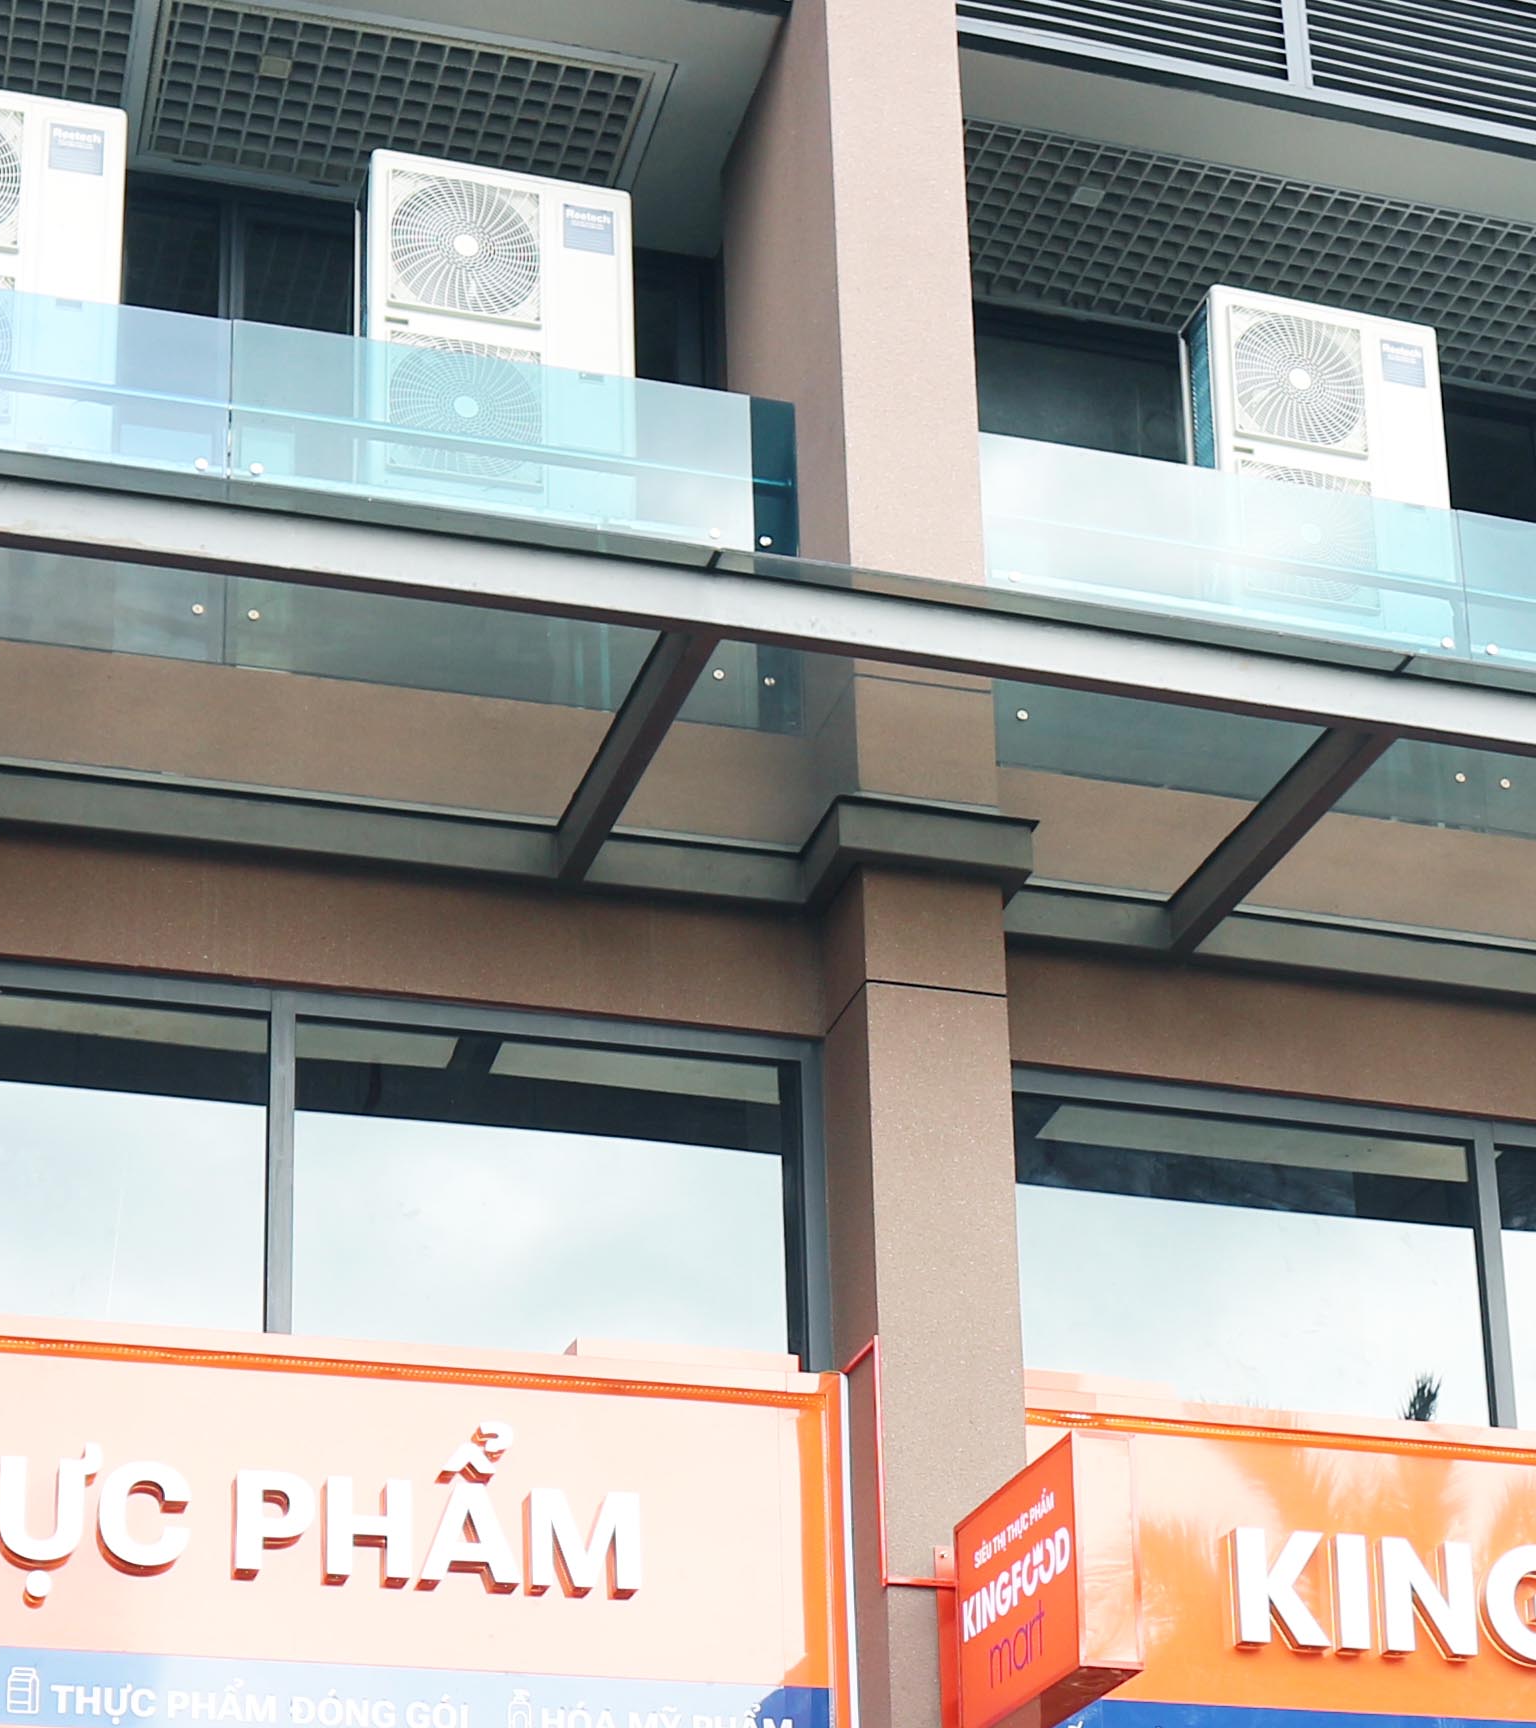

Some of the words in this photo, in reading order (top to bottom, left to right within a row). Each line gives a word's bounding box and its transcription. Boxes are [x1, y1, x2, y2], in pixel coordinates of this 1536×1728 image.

[232, 1420, 641, 1597] PHẨM
[974, 1540, 992, 1568] SIÊU
[993, 1534, 1007, 1551] THỊ
[1007, 1513, 1029, 1539] THỰC
[1029, 1488, 1055, 1525] PHẨM
[962, 1527, 1070, 1642] KINGFOOD
[990, 1600, 1045, 1689] mart
[50, 1680, 158, 1724] THỰC
[166, 1676, 277, 1727] PHẨM
